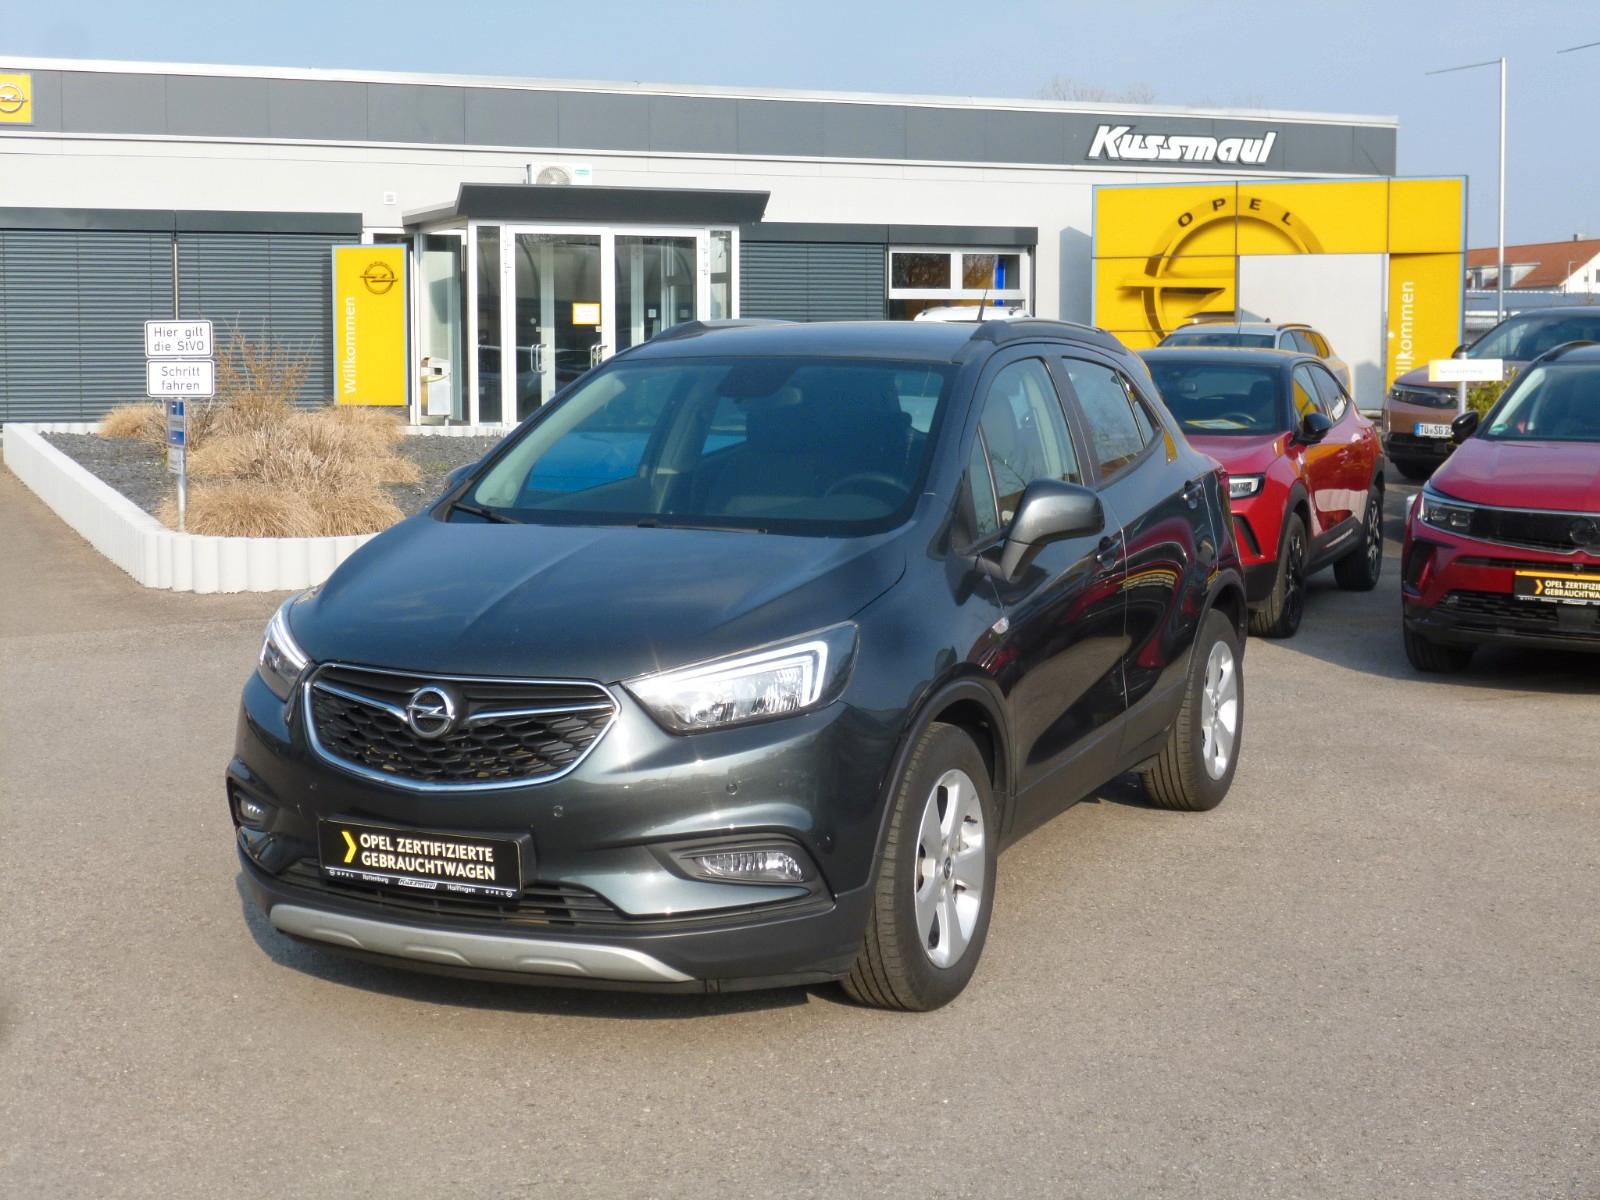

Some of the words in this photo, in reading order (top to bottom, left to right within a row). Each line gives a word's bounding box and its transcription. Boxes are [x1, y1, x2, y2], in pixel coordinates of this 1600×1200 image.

[1088, 125, 1277, 164] Kussmaul
[1177, 197, 1294, 228] OPEL
[154, 327, 178, 337] Hier
[185, 327, 203, 339] gilt
[1395, 281, 1414, 376] illkommen
[154, 341, 171, 351] die
[177, 340, 204, 351] StVO
[343, 296, 356, 394] Willkommen
[161, 366, 200, 376] Schritt
[161, 380, 200, 390] fahren
[1545, 580, 1564, 588] OPEL
[360, 833, 394, 850] OPEL
[397, 838, 494, 863] ZERTIFIZIERTE
[361, 851, 496, 881] GEBRAUCHTWAGEN
